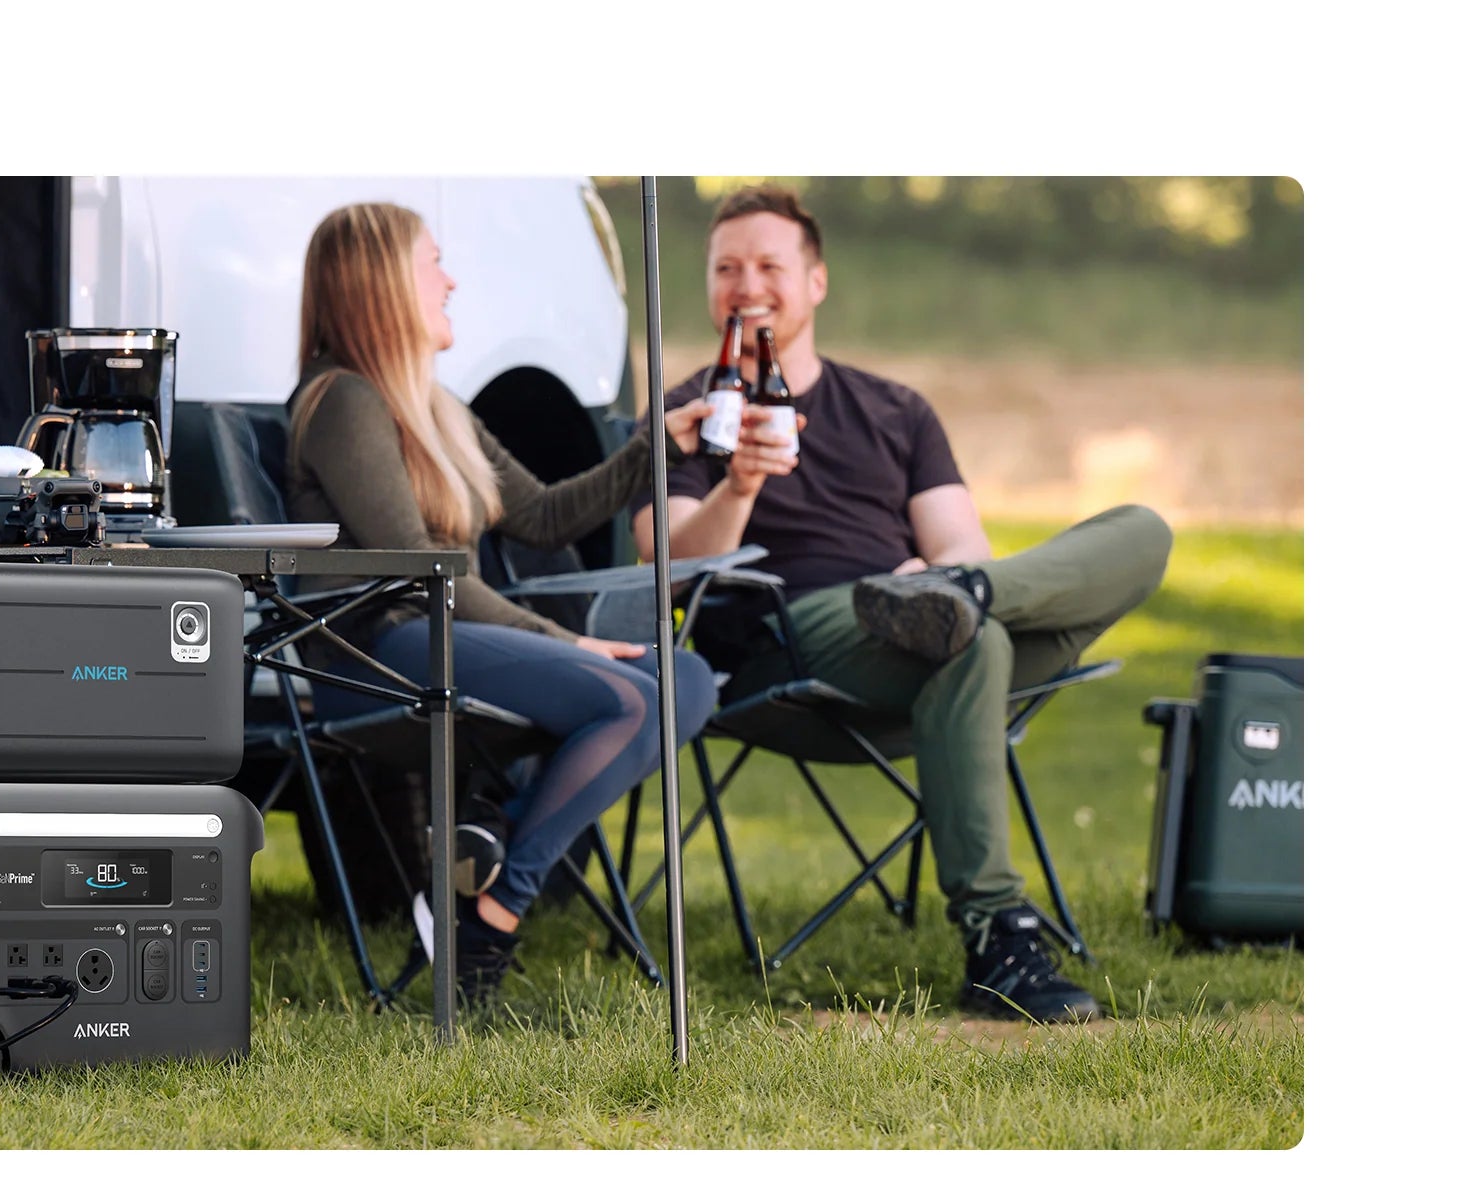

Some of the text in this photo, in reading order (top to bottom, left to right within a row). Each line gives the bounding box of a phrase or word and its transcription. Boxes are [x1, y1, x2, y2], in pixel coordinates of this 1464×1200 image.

[71, 665, 128, 682] ANKER
[1228, 777, 1304, 811] ANK
[74, 1022, 131, 1039] ANKER
